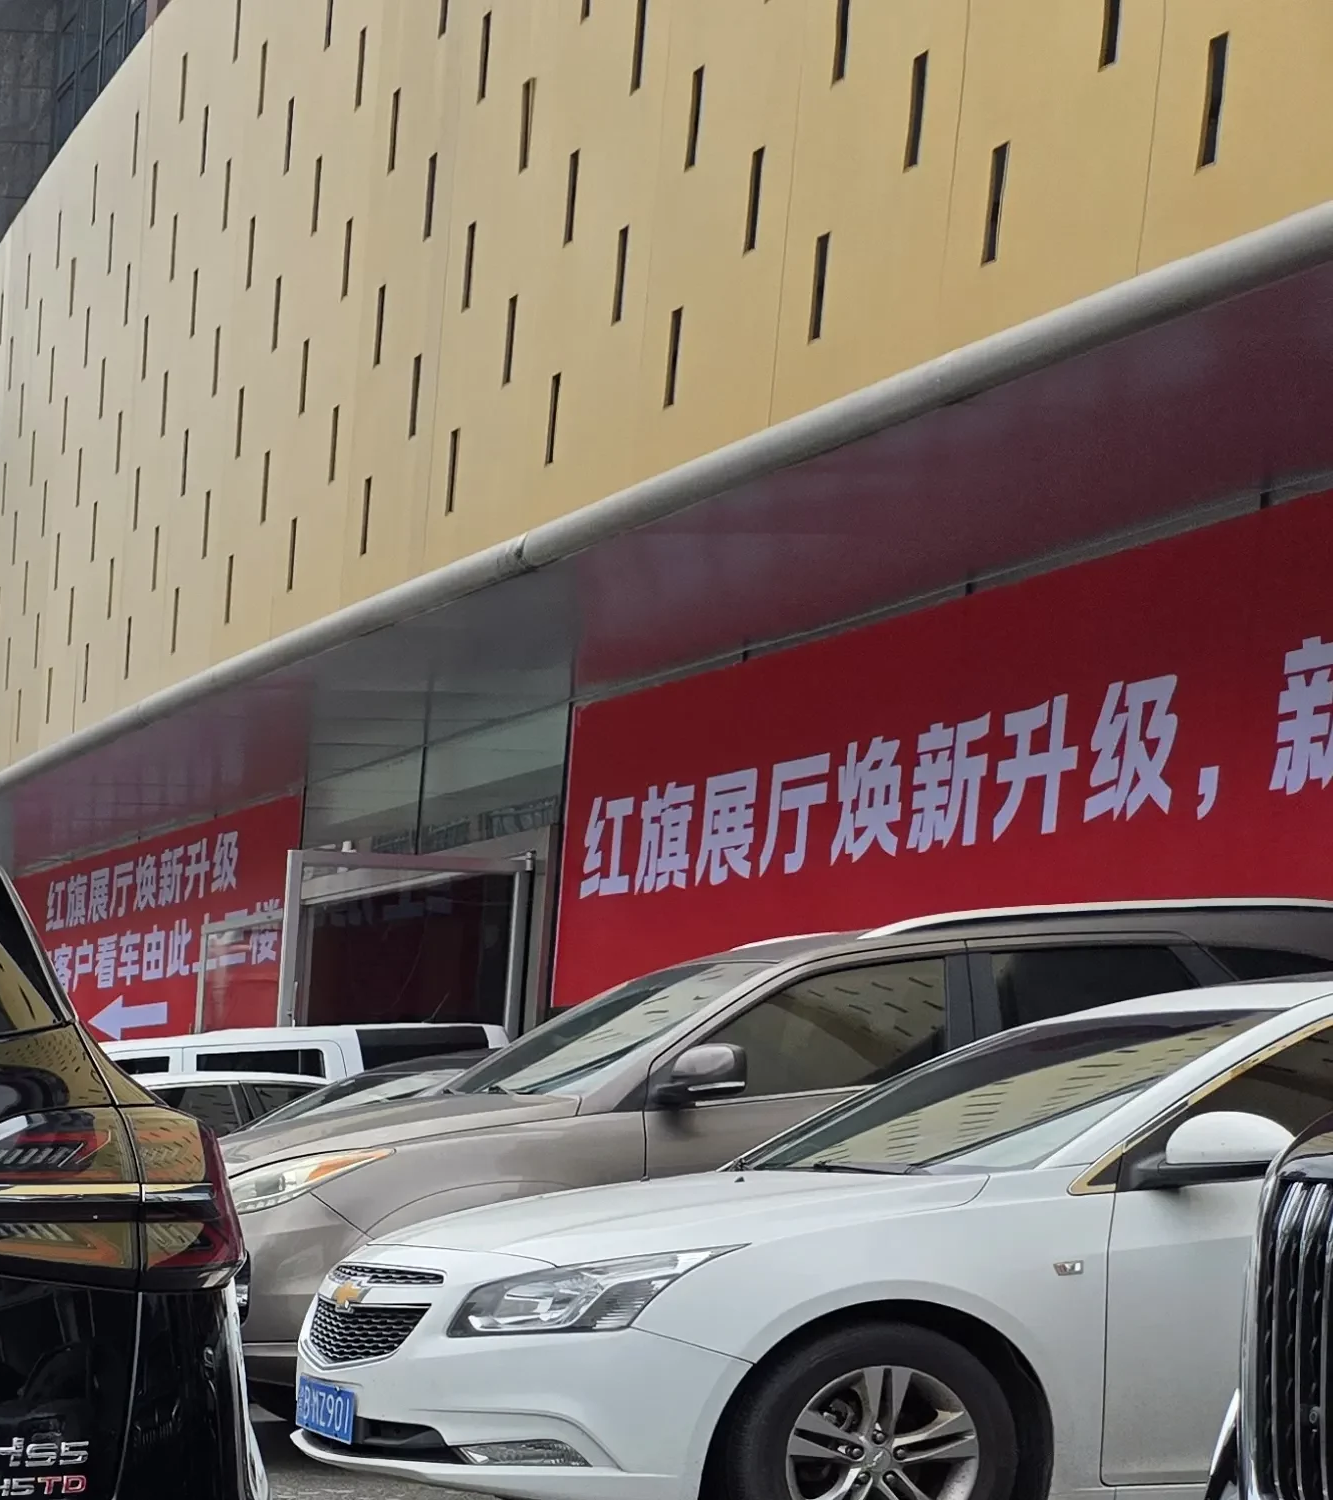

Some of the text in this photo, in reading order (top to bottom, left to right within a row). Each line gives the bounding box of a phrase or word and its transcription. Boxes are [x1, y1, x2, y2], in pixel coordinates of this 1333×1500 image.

[45, 831, 239, 931] 红旗展厅焕新升级
[47, 898, 284, 994] 客户看车由此上二楼
